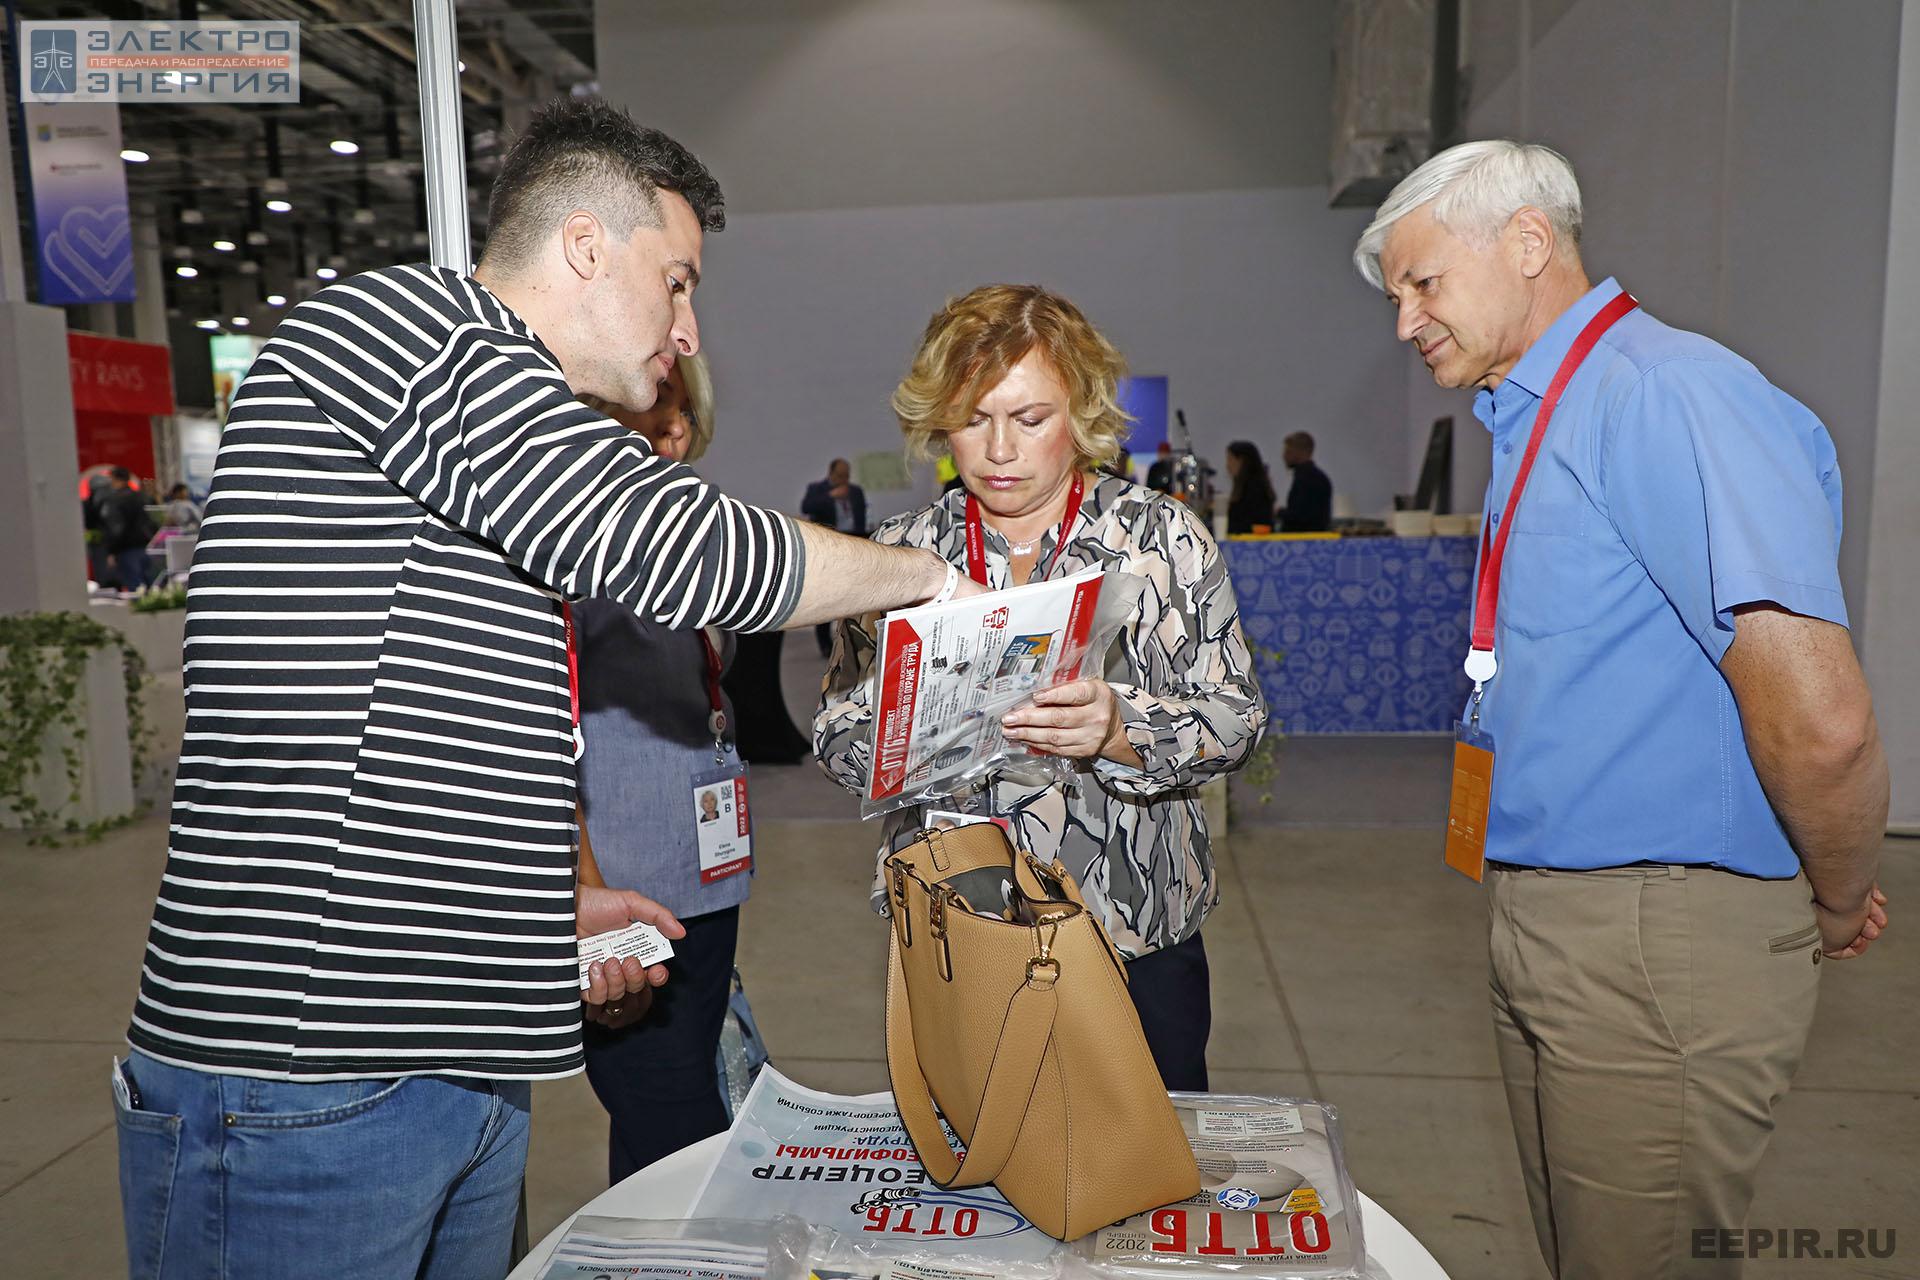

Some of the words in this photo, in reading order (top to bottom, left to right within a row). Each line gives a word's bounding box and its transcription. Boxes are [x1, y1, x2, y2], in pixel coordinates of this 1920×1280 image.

[907, 642, 919, 666] ТРУДА
[906, 668, 915, 693] ОХРАНЕ
[904, 694, 912, 703] ПО
[825, 1110, 896, 1119] ЕОРЕПОРТАЖИ
[814, 1123, 905, 1133] ИДЕОИНСТРУКЦИИ
[852, 1135, 909, 1146] ТРУДА:
[750, 1163, 924, 1184] ЕОЦЕНТР
[861, 1205, 980, 1237] ОТТБ
[1149, 1209, 1331, 1256] ОТТБ
[1105, 1238, 1145, 1251] 2022
